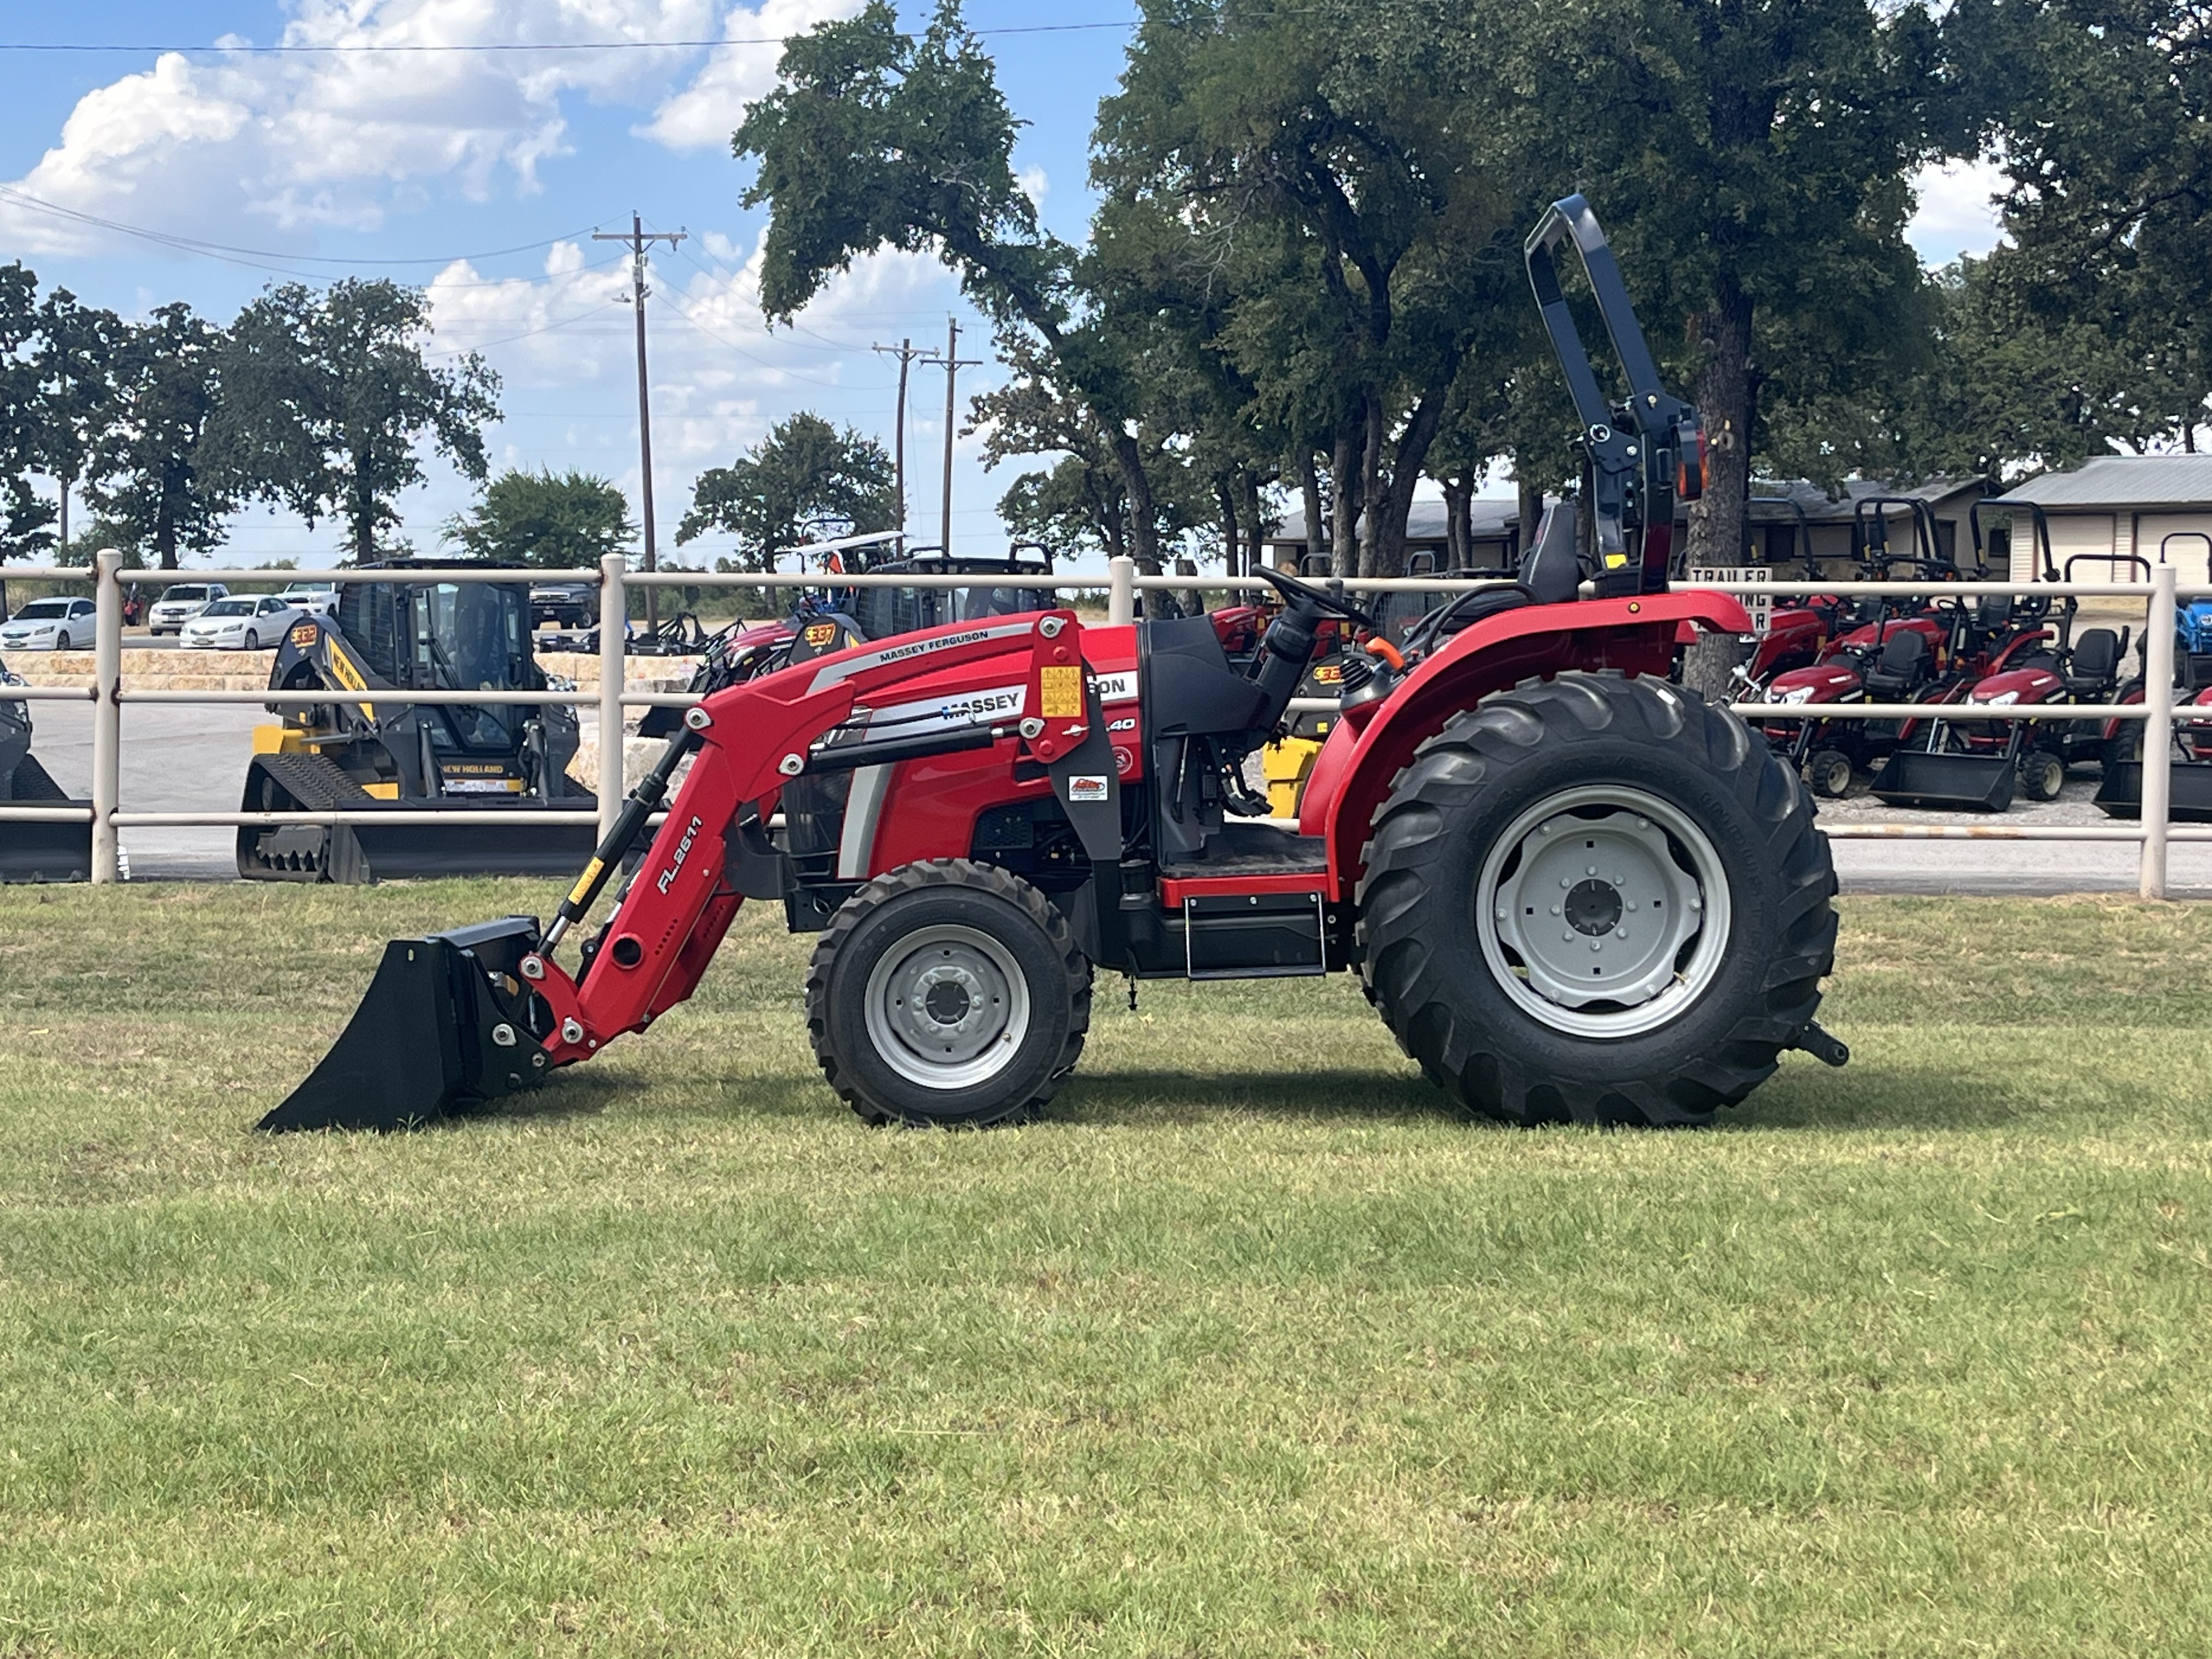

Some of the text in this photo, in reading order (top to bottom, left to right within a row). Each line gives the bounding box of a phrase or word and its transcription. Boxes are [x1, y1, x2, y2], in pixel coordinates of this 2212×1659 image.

[1692, 569, 1766, 582] TRAILER
[1739, 594, 1766, 607] ING
[879, 631, 989, 662] MASSEY FERGUSON
[462, 765, 504, 773] HOLLAND
